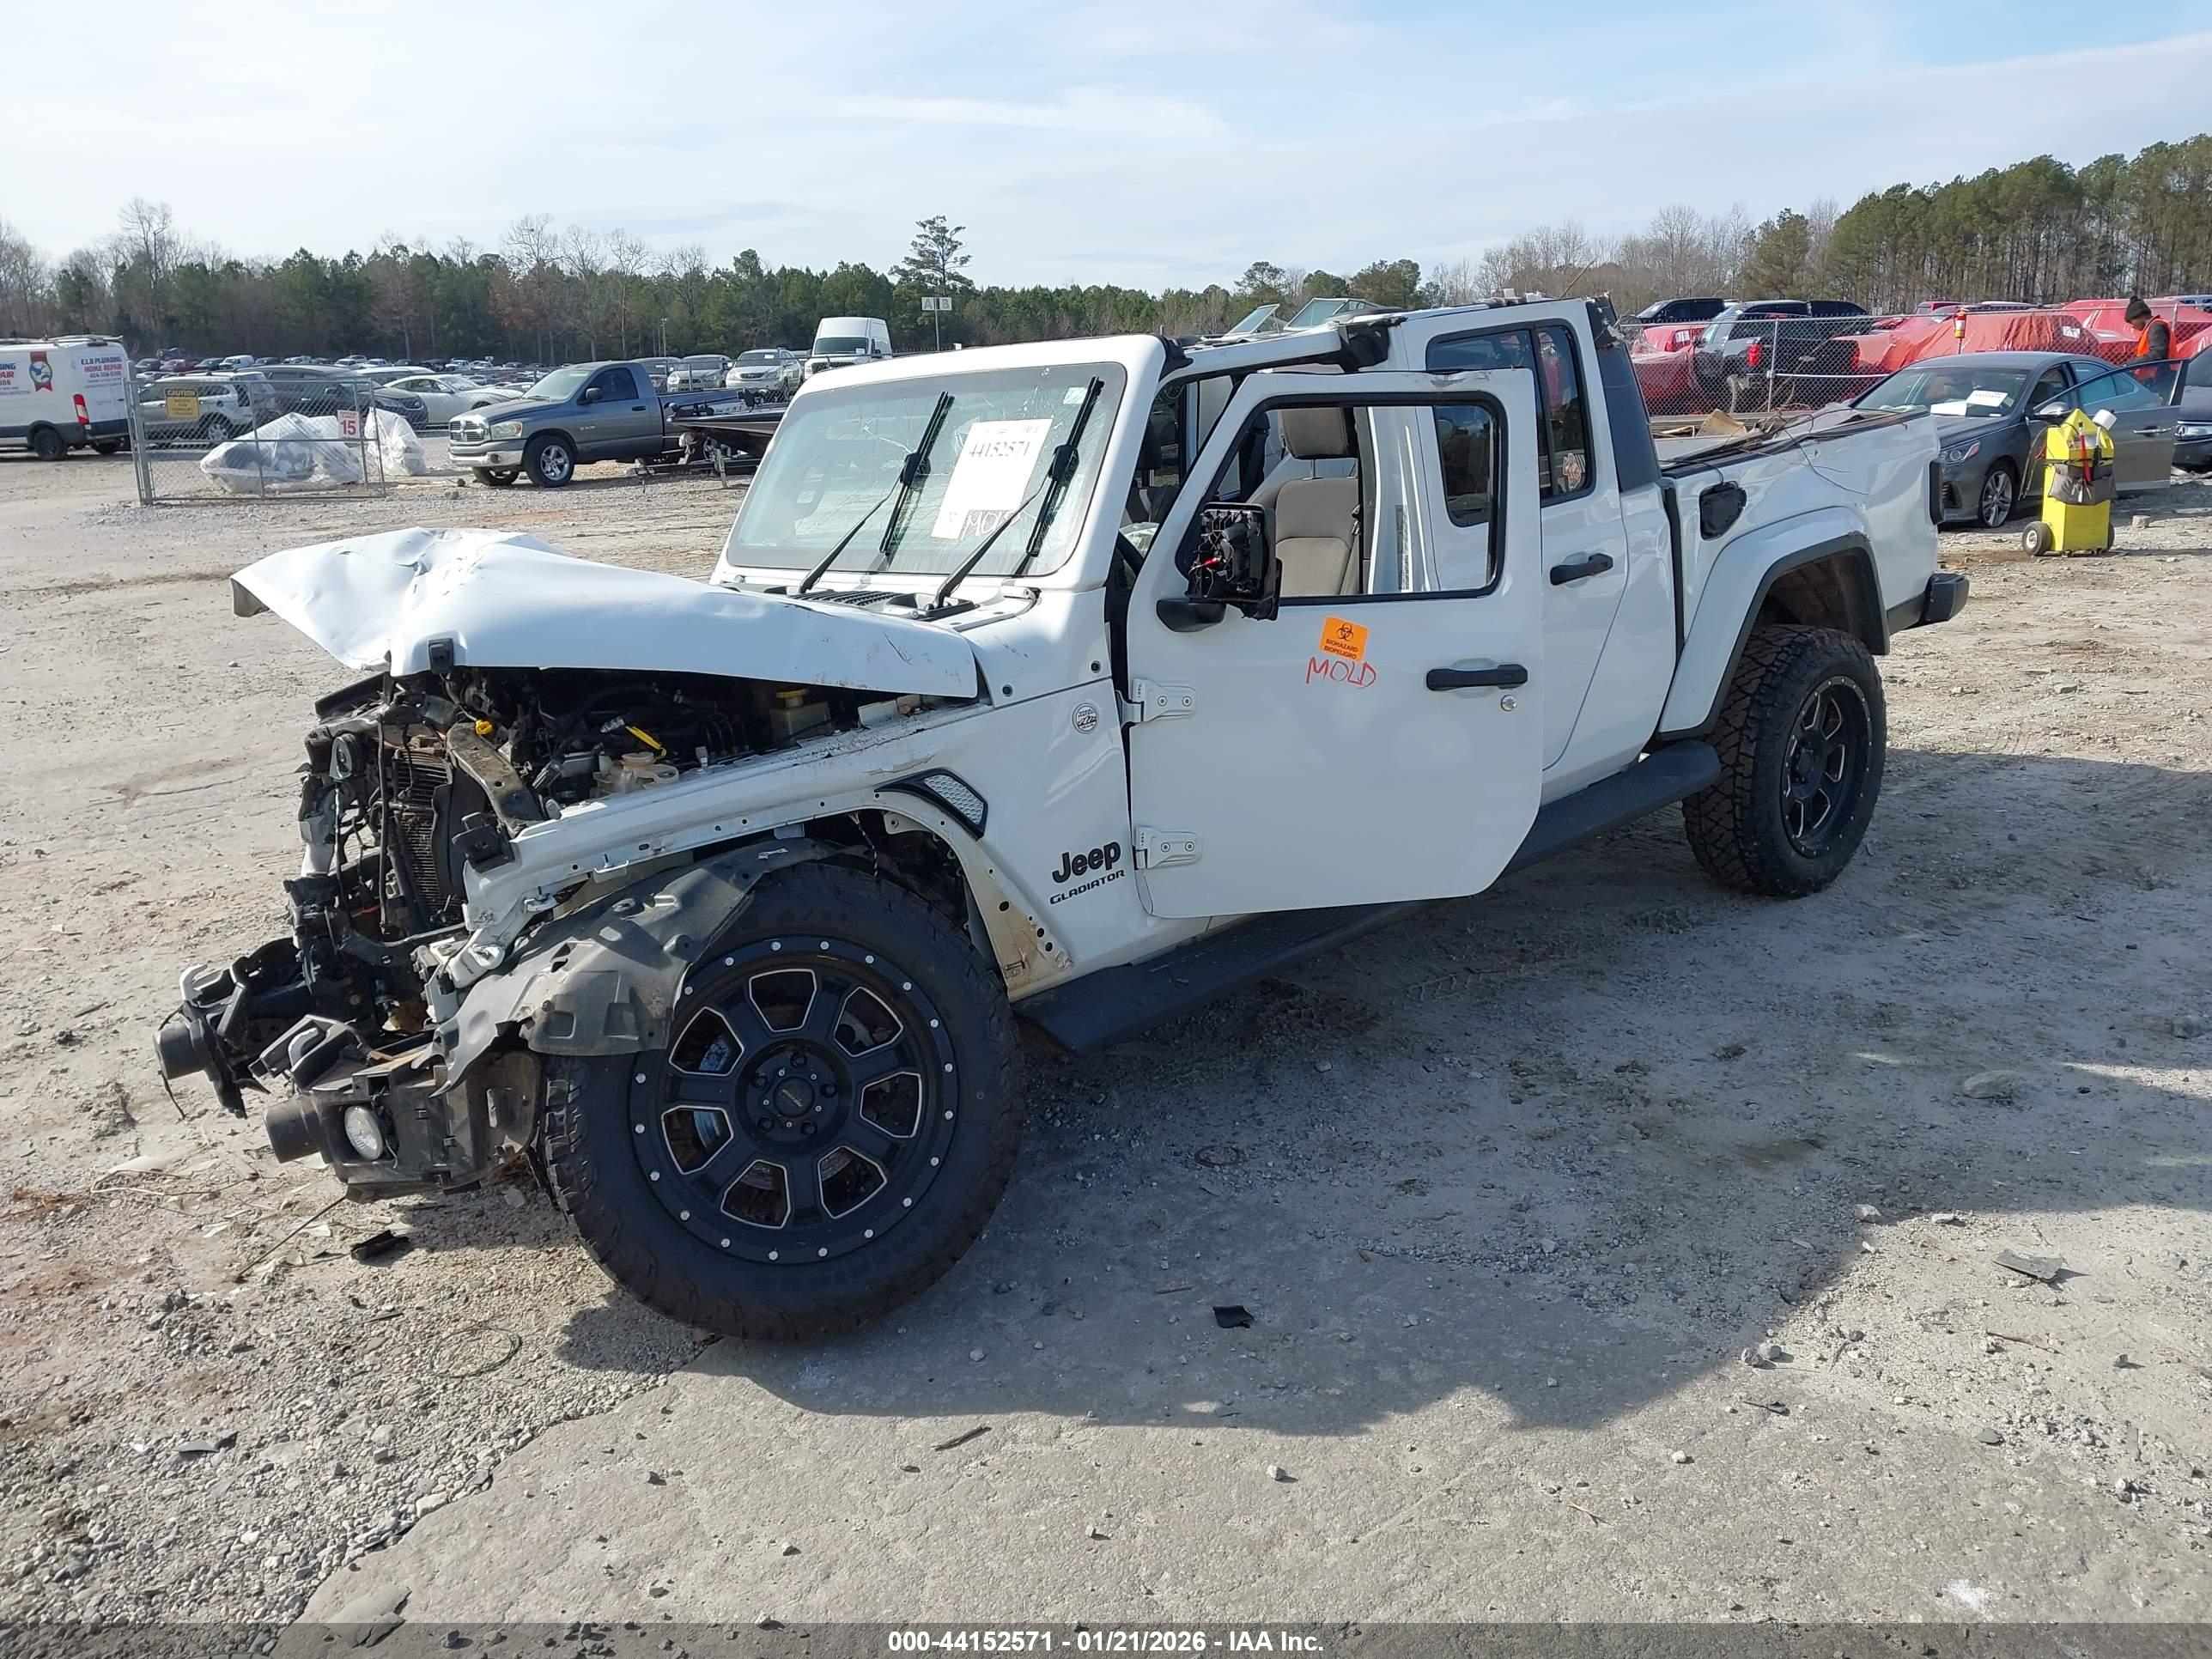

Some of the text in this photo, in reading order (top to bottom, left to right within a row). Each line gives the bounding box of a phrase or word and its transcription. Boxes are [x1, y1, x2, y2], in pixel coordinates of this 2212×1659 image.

[925, 298, 933, 309] A
[942, 298, 950, 309] B
[343, 420, 356, 435] 15
[969, 441, 1030, 457] 44152571
[1324, 645, 1357, 659] BIOPELIGRO
[1326, 638, 1358, 653] BIOHAZARD
[1305, 656, 1376, 690] MOLD
[1052, 841, 1122, 884] Jeep
[1049, 869, 1126, 905] GLADIATOR
